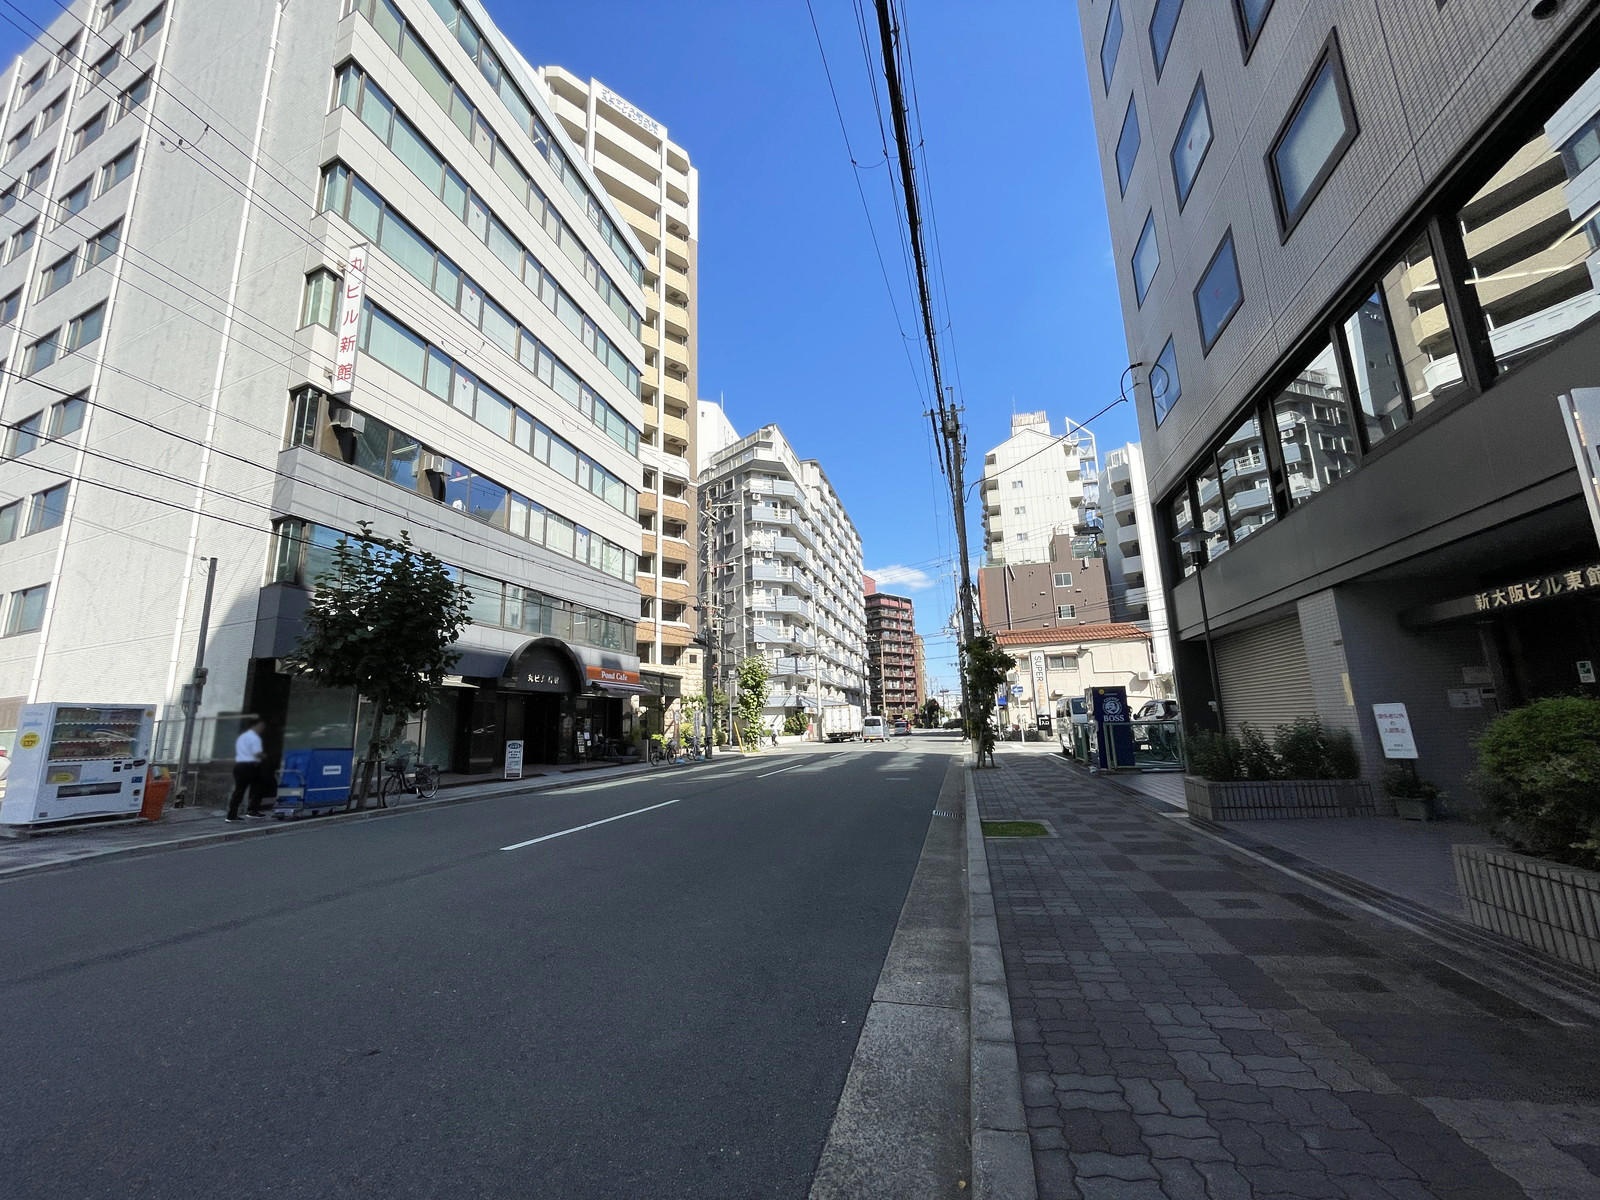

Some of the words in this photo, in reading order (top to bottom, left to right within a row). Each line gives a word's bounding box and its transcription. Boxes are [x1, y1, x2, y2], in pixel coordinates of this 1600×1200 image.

[336, 257, 365, 381] 丸ビル新館
[1474, 565, 1600, 611] 新大阪ビル東館
[601, 670, 615, 680] Pond
[616, 672, 628, 681] Cafe
[1103, 714, 1125, 722] BOSS
